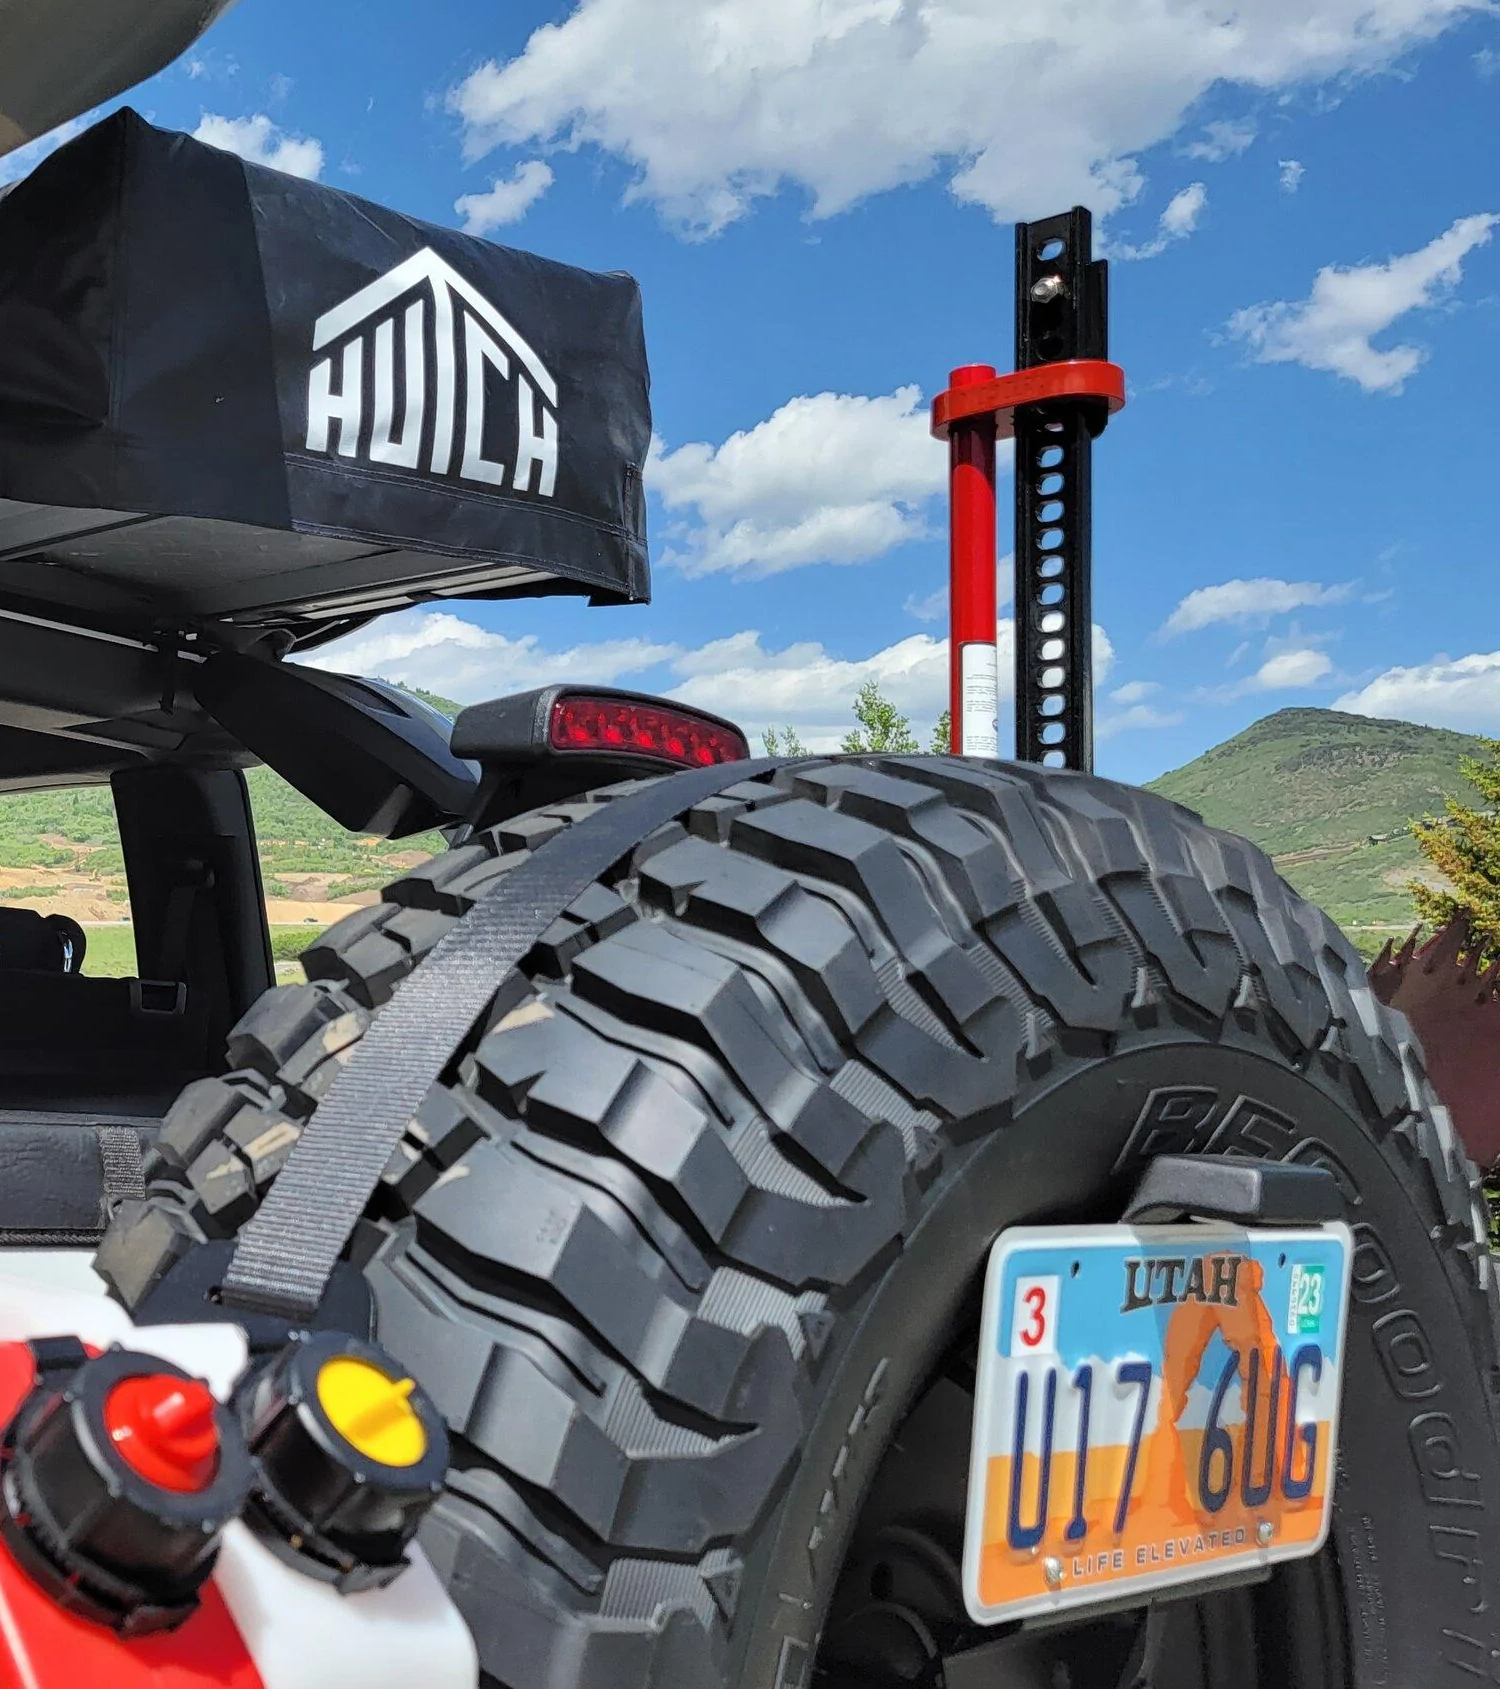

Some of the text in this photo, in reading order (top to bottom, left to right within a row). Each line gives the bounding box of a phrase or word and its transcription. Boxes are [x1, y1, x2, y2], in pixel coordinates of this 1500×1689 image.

[306, 247, 558, 497] HUTCH
[1120, 1255, 1243, 1312] UTAH
[1298, 1272, 1323, 1315] 23
[1019, 1286, 1046, 1347] 3
[1006, 1342, 1323, 1549] U17 6UG
[1072, 1527, 1246, 1577] LIFE ELEVATED
